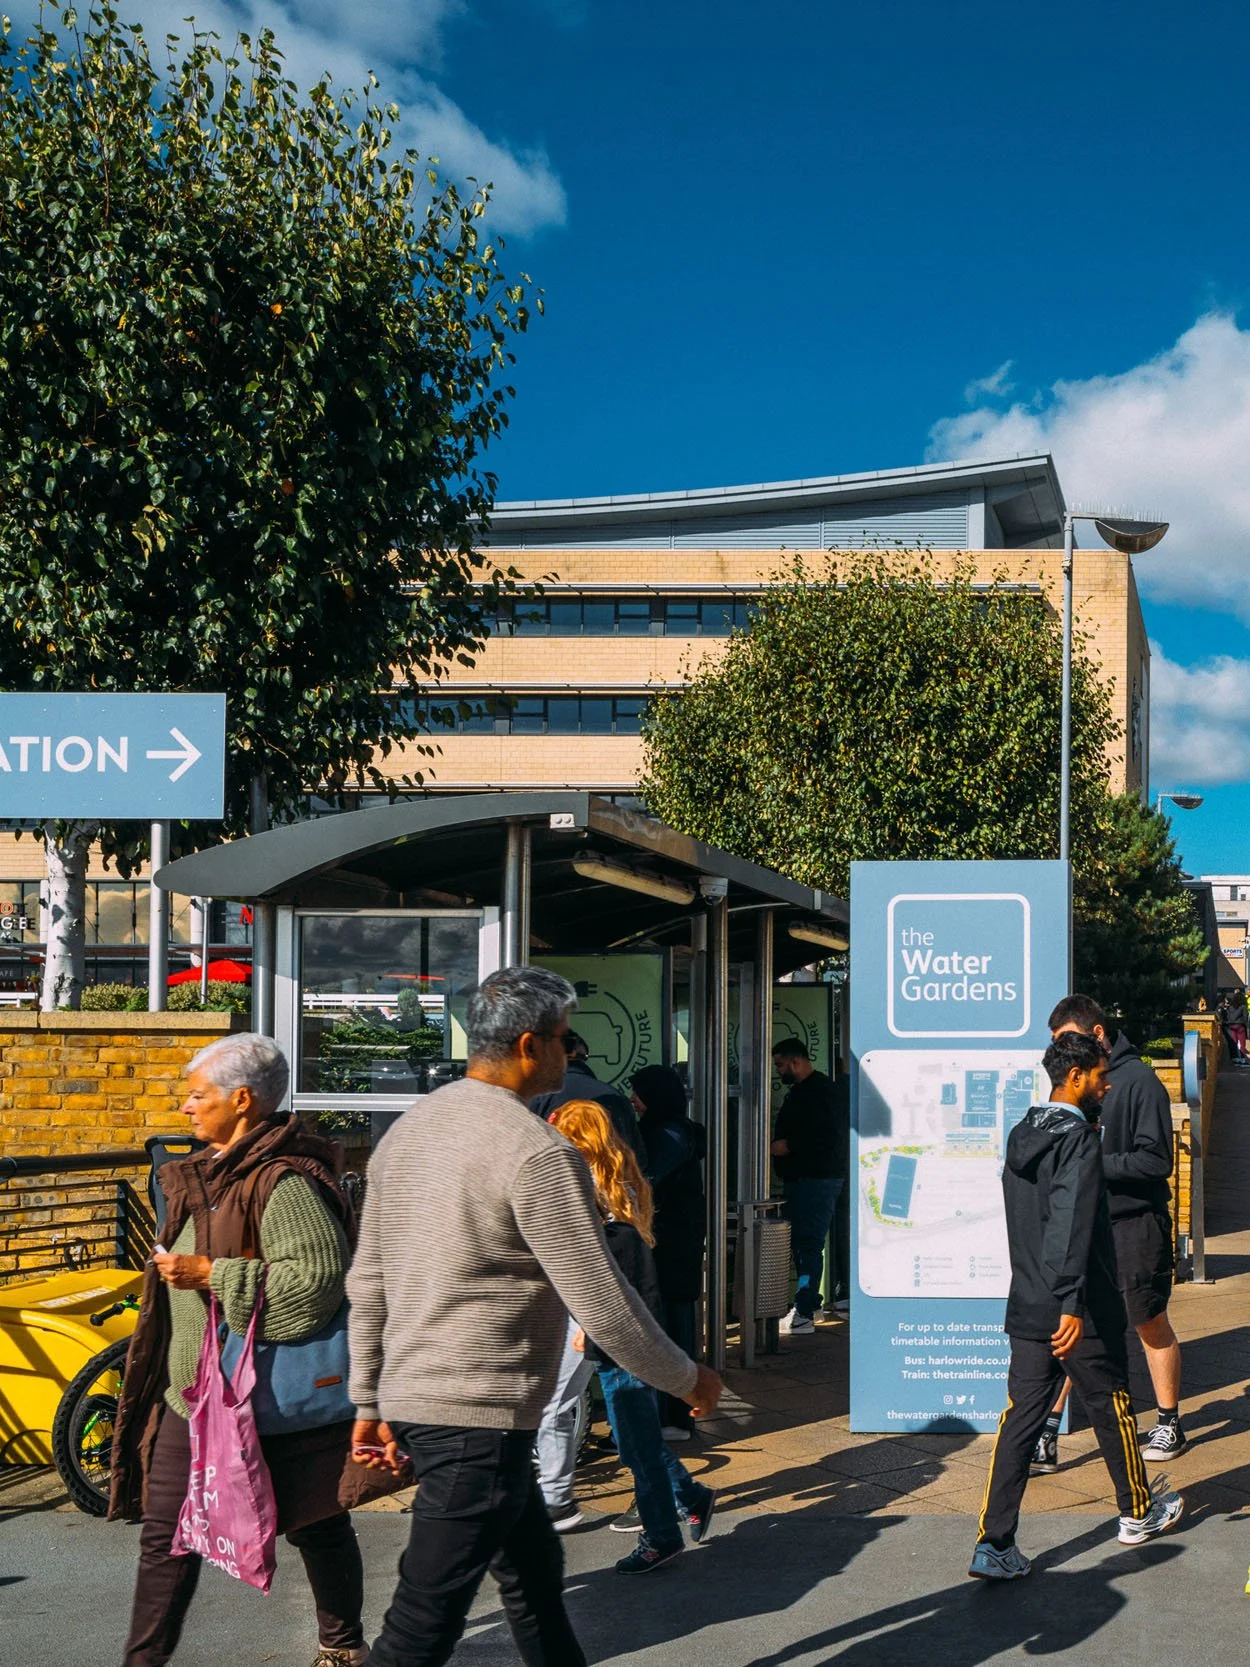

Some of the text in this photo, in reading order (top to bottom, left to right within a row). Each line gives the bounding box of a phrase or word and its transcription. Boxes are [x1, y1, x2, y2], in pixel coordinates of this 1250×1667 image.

[901, 927, 934, 946] the
[901, 949, 992, 975] Water
[901, 975, 1017, 1001] Gardens
[807, 1020, 820, 1062] UTURE
[898, 1322, 1005, 1333] For up to date transp
[891, 1336, 939, 1346] timetable
[942, 1336, 1000, 1346] information
[905, 1356, 925, 1365] Bus:
[902, 1369, 1009, 1379] Train: thetrainline.co
[216, 1535, 236, 1558] ON
